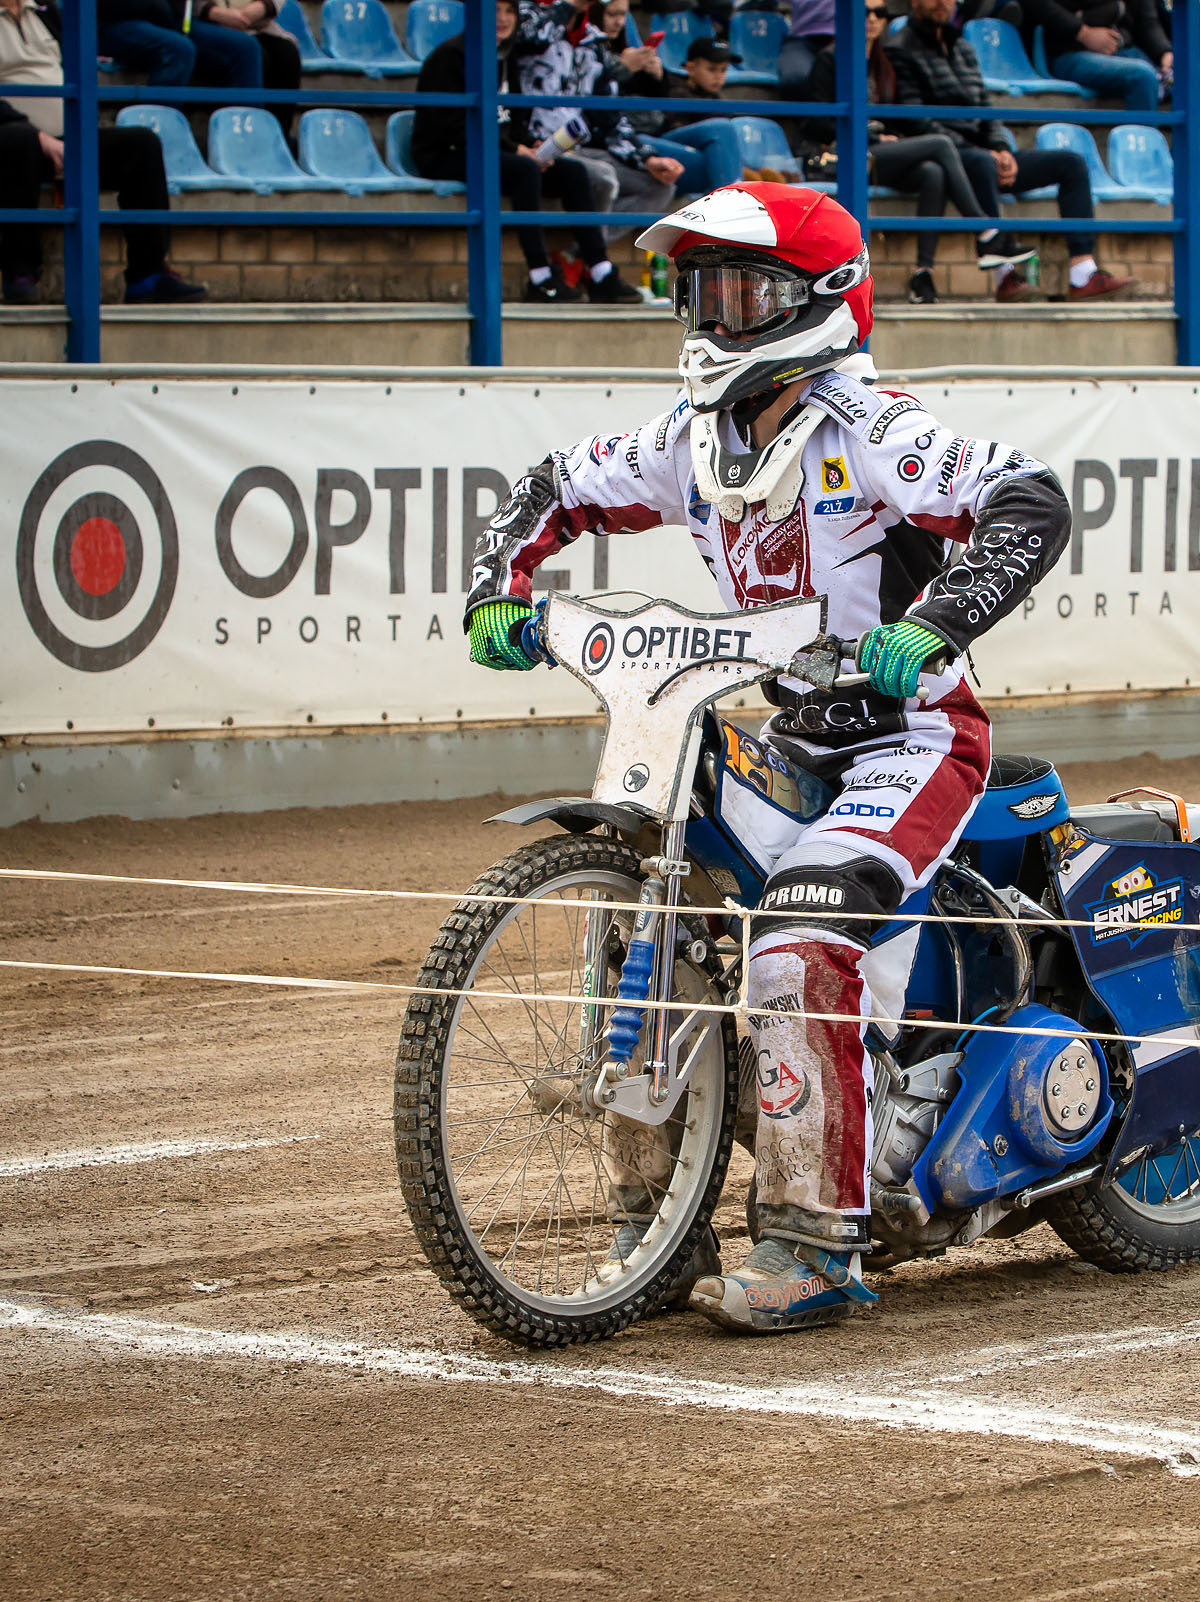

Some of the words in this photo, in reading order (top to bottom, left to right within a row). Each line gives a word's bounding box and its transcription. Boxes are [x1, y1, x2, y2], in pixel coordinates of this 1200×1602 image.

[343, 2, 367, 20] 27
[822, 499, 844, 513] 2LŻ
[215, 465, 610, 598] OPTIB
[762, 514, 800, 550] DAUGAVPILS
[934, 523, 1016, 600] YOGGI
[976, 548, 1041, 616] BEAR
[1022, 589, 1173, 620] PORTA
[215, 614, 444, 645] SPORTA
[622, 625, 752, 659] OPTIBET
[621, 660, 682, 671] SPORTA
[763, 884, 843, 910] PROMO
[1093, 885, 1181, 932] ERNEST
[1139, 907, 1182, 931] RACING
[757, 1048, 802, 1090] GA
